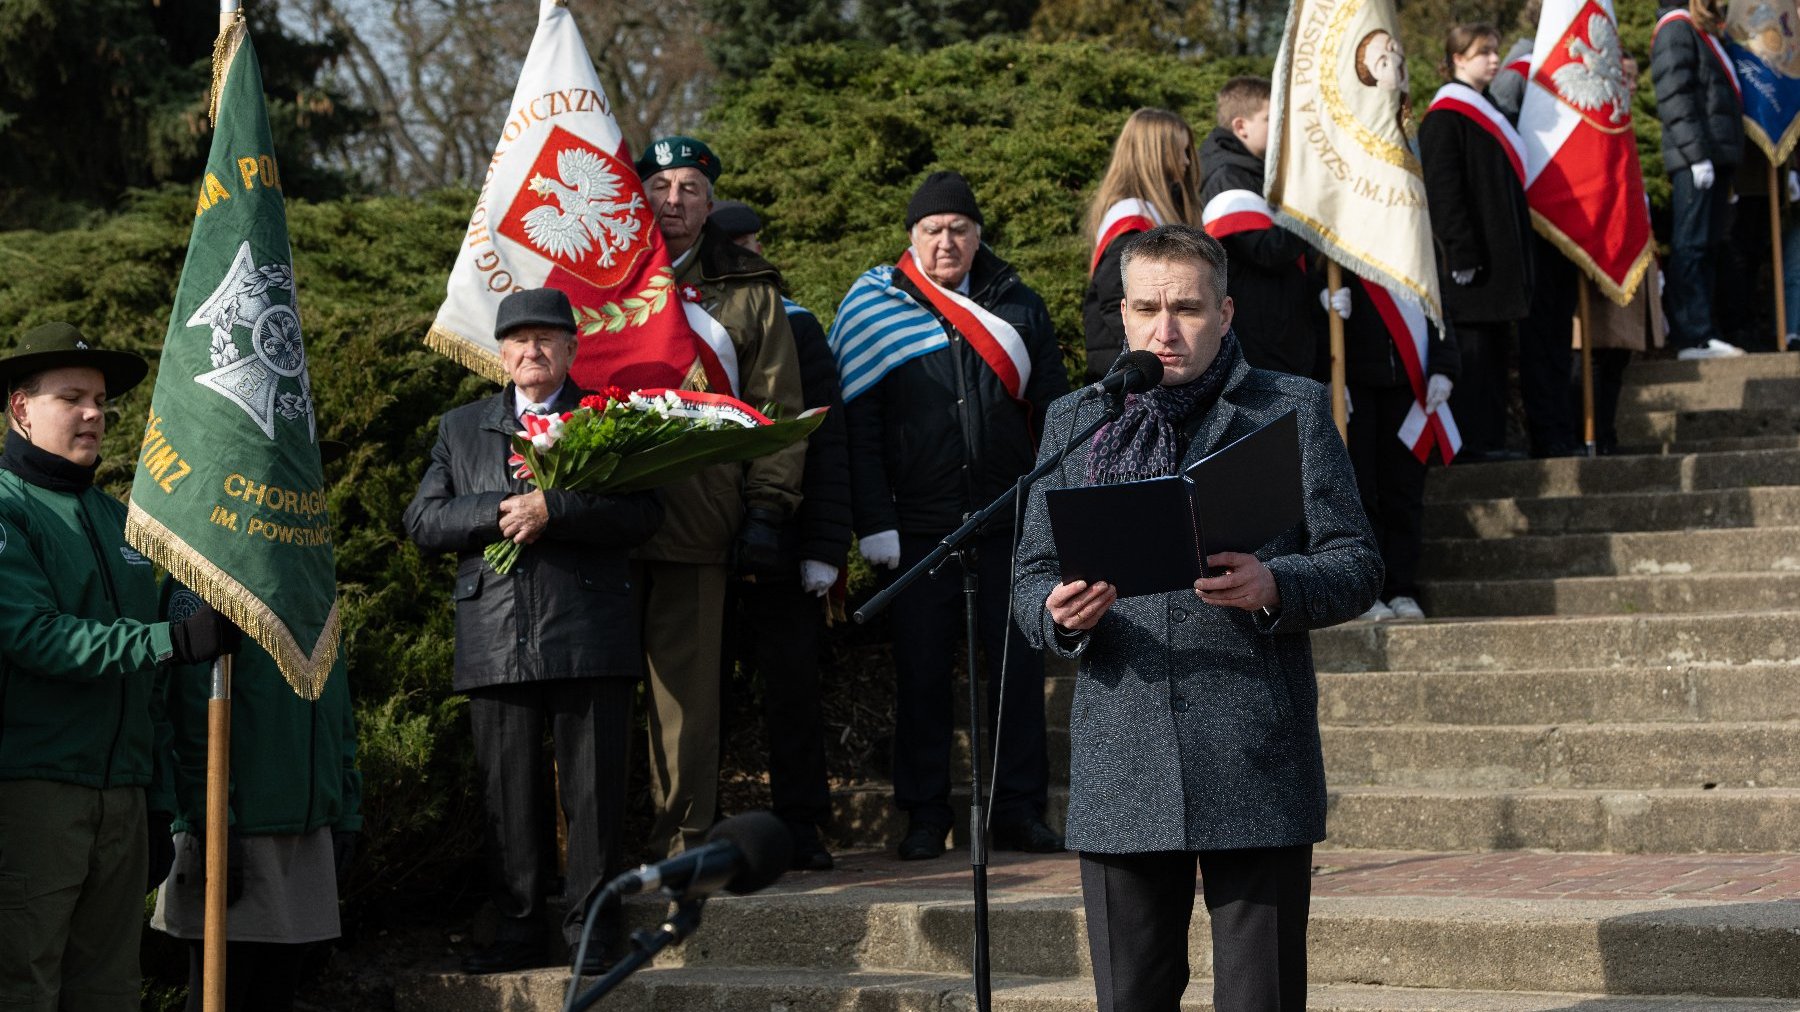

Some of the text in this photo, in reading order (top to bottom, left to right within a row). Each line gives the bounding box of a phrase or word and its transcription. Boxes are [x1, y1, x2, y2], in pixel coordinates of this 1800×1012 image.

[1295, 0, 1337, 86] PODSTA
[502, 88, 612, 142] OJCZYZN
[209, 505, 333, 547] IM. POWSTAŃC
